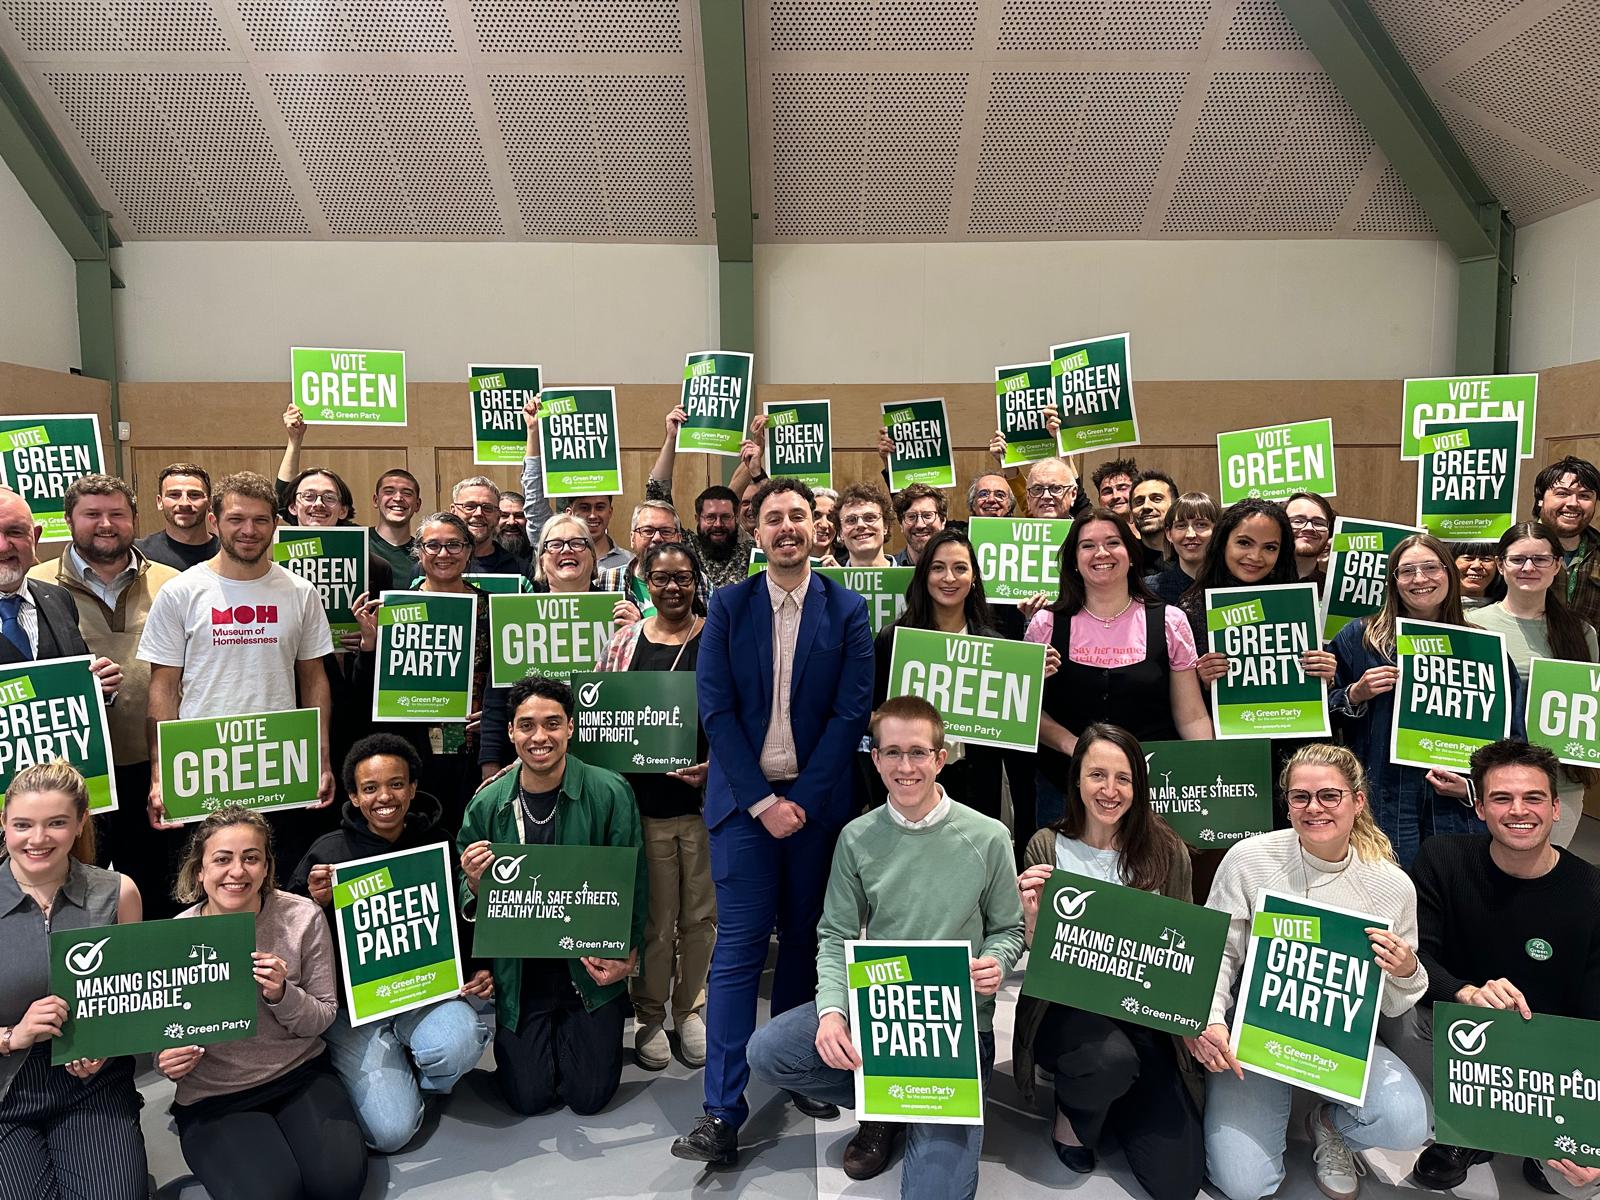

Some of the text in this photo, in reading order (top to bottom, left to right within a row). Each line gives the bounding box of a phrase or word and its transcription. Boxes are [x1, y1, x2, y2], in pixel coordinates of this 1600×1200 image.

[330, 353, 367, 371] VOTE
[691, 362, 713, 376] VOTE
[1061, 354, 1084, 372] VOTE
[301, 371, 397, 408] GREEN
[479, 376, 503, 390] VOTE
[689, 376, 742, 398] GREEN
[1004, 376, 1025, 392] VOTE
[1061, 363, 1121, 395] GREEN
[480, 389, 534, 410] GREEN
[1005, 388, 1054, 411] GREEN
[1448, 380, 1491, 401] VOTE
[547, 399, 573, 415] VOTE
[687, 397, 740, 420] PARTY
[1062, 387, 1121, 417] PARTY
[336, 411, 380, 421] Green Party
[482, 409, 524, 431] PART
[549, 413, 608, 437] GREEN
[774, 412, 796, 426] VOTE
[890, 410, 911, 424] VOTE
[1006, 409, 1046, 432] PART
[8, 430, 42, 448] VOTE
[775, 423, 824, 444] GREEN
[893, 419, 941, 441] GREEN
[1087, 429, 1102, 437] Green
[1102, 426, 1119, 435] Party
[1254, 429, 1292, 450] VOTE
[551, 435, 608, 461] PARTY
[895, 438, 942, 461] PARTY
[1433, 433, 1464, 451] VOTE
[13, 445, 92, 474] GREEN
[776, 442, 825, 465] PARTY
[1432, 449, 1507, 476] GREEN
[1227, 443, 1325, 489] GREEN
[16, 471, 92, 500] PART
[1262, 488, 1284, 498] Green
[1431, 474, 1506, 501] PARTY
[1012, 522, 1052, 541] VOTE
[1453, 518, 1493, 528] Green Party
[287, 541, 318, 558] VOTE
[1348, 535, 1378, 550] VOTE
[288, 557, 358, 583] GREEN
[980, 542, 1059, 584] GREE
[1344, 550, 1389, 580] GRE
[843, 572, 883, 591] VOTE
[1339, 576, 1388, 607] PAR
[320, 583, 358, 610] RTY
[212, 605, 278, 625] MOH
[392, 606, 422, 622] VOTE
[536, 599, 579, 620] VOTE
[1222, 604, 1258, 625] VOTE
[212, 627, 265, 637] Museum of
[212, 636, 278, 646] Homelessness
[391, 624, 463, 650] GREEN
[502, 621, 616, 665] GREEN
[1224, 622, 1308, 656] GREEN
[946, 639, 995, 667] VOTE
[1072, 646, 1092, 656] Say
[1094, 646, 1109, 654] her
[1411, 638, 1444, 654] VOTE
[389, 650, 462, 677] PARTY
[1096, 656, 1114, 664] her
[1226, 651, 1307, 688] PARTY
[543, 670, 570, 679] Green
[1413, 654, 1496, 692] GREEN
[432, 696, 450, 705] Party
[900, 659, 1031, 723] GREEN
[1410, 682, 1496, 722] PARTY
[578, 705, 684, 728] HOMES FOR PEOPLE,
[1256, 709, 1301, 718] Green Party
[216, 718, 267, 744] VOTE
[578, 727, 639, 746] NOT PROFIT.
[944, 720, 1002, 738] Green Party
[1434, 740, 1458, 750] Green
[173, 739, 308, 798] GREEN
[646, 756, 692, 767] Green Party
[223, 792, 285, 807] Green Party
[1159, 786, 1180, 801] AIR,
[1182, 785, 1208, 800] SAFE
[1210, 783, 1258, 799] STREETS,
[1217, 830, 1243, 840] Green
[348, 873, 385, 900] VOTE
[352, 882, 440, 932] GREEN
[488, 890, 620, 907] CLEAN AIR, SAFE STREETS,
[488, 904, 535, 919] HEALTHY
[356, 914, 441, 965] PARTY
[1272, 918, 1313, 940] VOTE
[576, 940, 626, 951] Green Party
[1054, 922, 1195, 975] MAKING ISLINGTON
[864, 961, 904, 984] VOTE
[1050, 941, 1152, 990] AFFORDABLE.
[1266, 938, 1370, 997] GREEN
[76, 962, 230, 999] MAKING ISLINGTON
[391, 972, 436, 992] Green Party
[76, 987, 192, 1020] AFFORDABLE.
[869, 984, 961, 1022] GREEN
[1259, 972, 1365, 1033] PARTY
[186, 1019, 252, 1036] Green Party
[1141, 1005, 1202, 1031] Green Party
[871, 1022, 962, 1059] PARTY
[1284, 1044, 1339, 1072] Green Party
[1449, 1059, 1512, 1089] HOMES
[1518, 1065, 1554, 1094] FOR
[905, 1085, 956, 1097] Green Party
[1449, 1082, 1565, 1125] NOT PROFIT.
[1580, 1144, 1600, 1157] Gre
